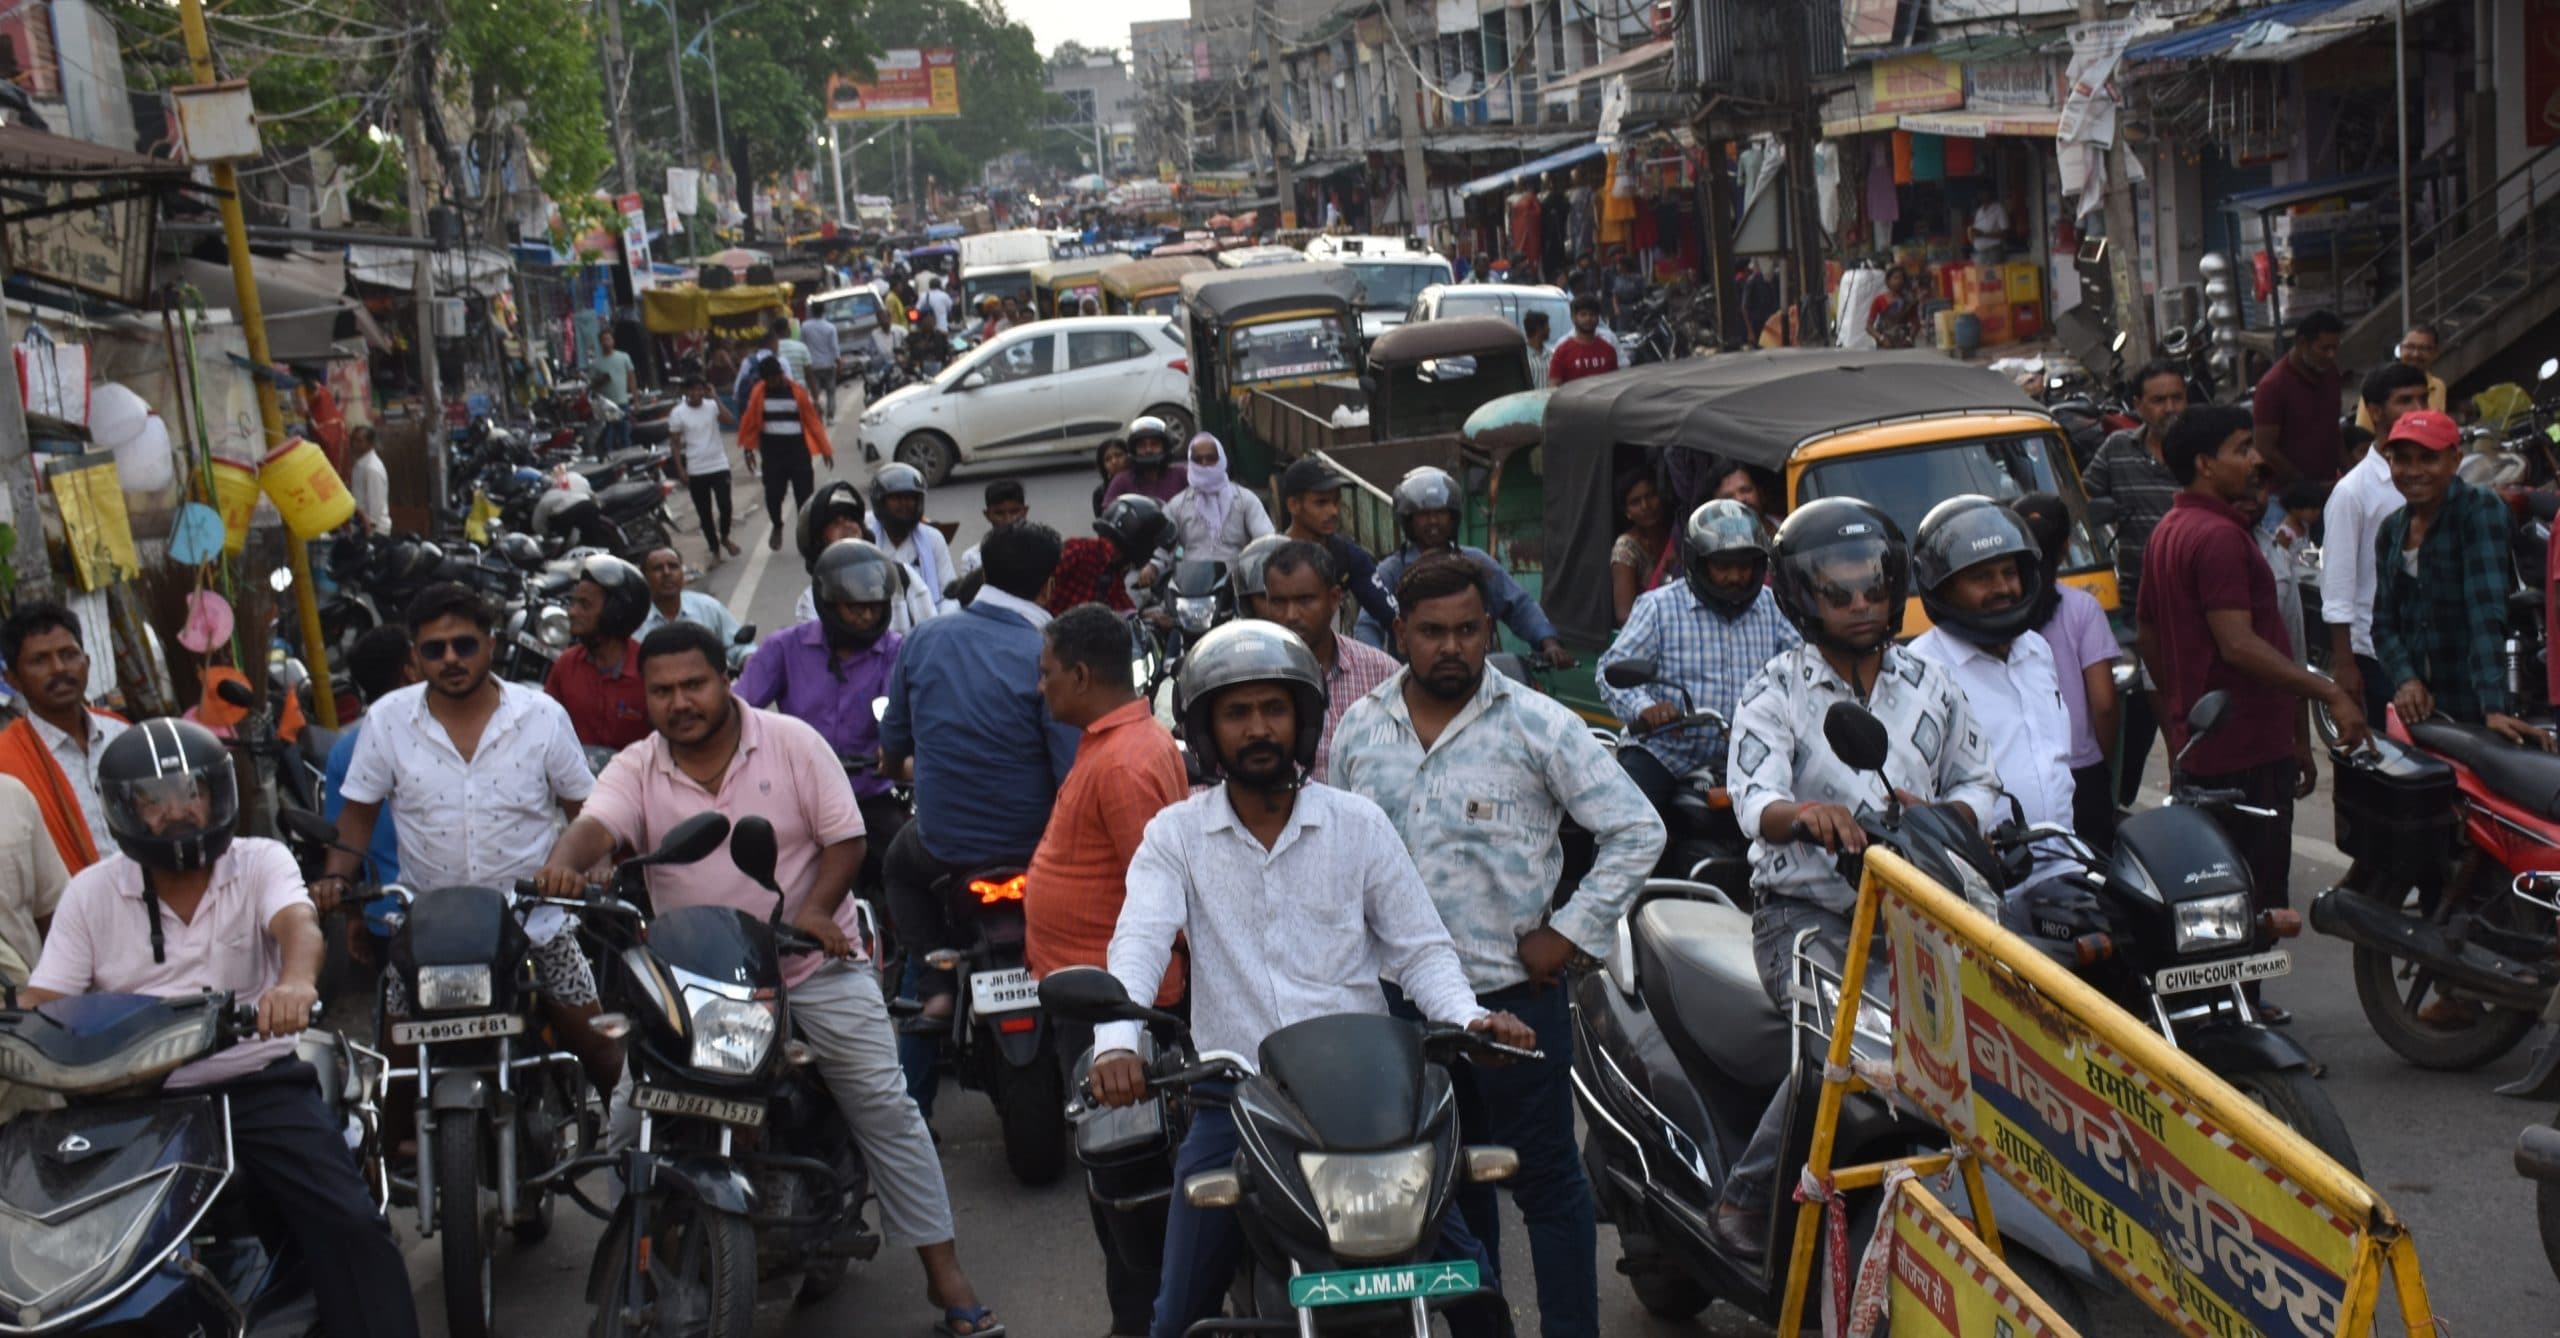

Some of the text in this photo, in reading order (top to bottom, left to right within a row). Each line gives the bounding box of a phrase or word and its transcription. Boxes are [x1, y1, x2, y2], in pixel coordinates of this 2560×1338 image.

[1968, 1018, 2142, 1196] बोकारो
[2084, 1056, 2166, 1143] समर्पित
[1994, 1119, 2057, 1195] आपकी
[2059, 1167, 2097, 1231] सेवा
[1354, 1272, 1415, 1297] J.M.M
[1852, 1257, 1877, 1333] DANGER
